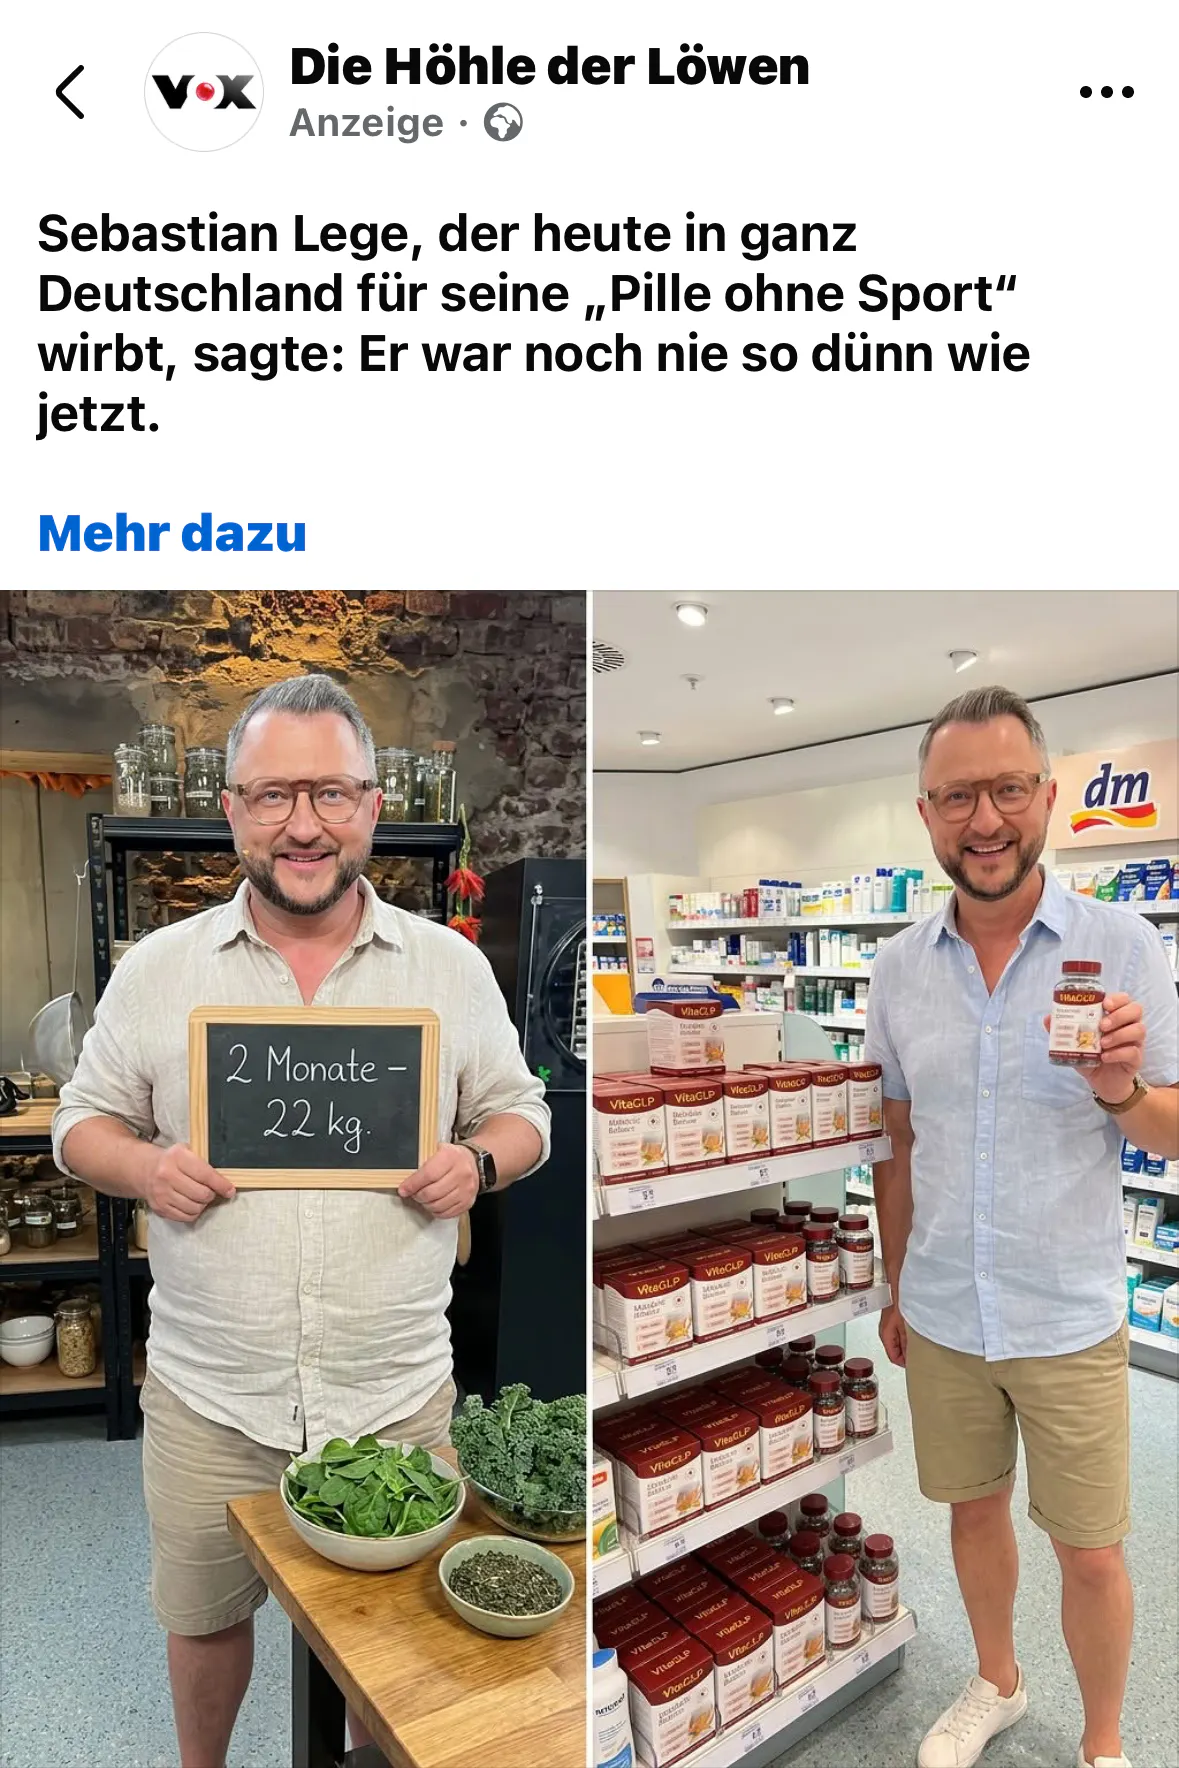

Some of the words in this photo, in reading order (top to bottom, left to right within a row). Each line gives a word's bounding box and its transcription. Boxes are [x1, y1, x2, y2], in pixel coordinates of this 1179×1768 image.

[1085, 763, 1150, 808] dm
[226, 1043, 252, 1084] 2
[267, 1045, 378, 1083] Monate
[610, 1096, 655, 1110] VitaGLP
[674, 1091, 716, 1103] VitaGLP
[263, 1098, 315, 1138] 22
[328, 1101, 371, 1154] kg.
